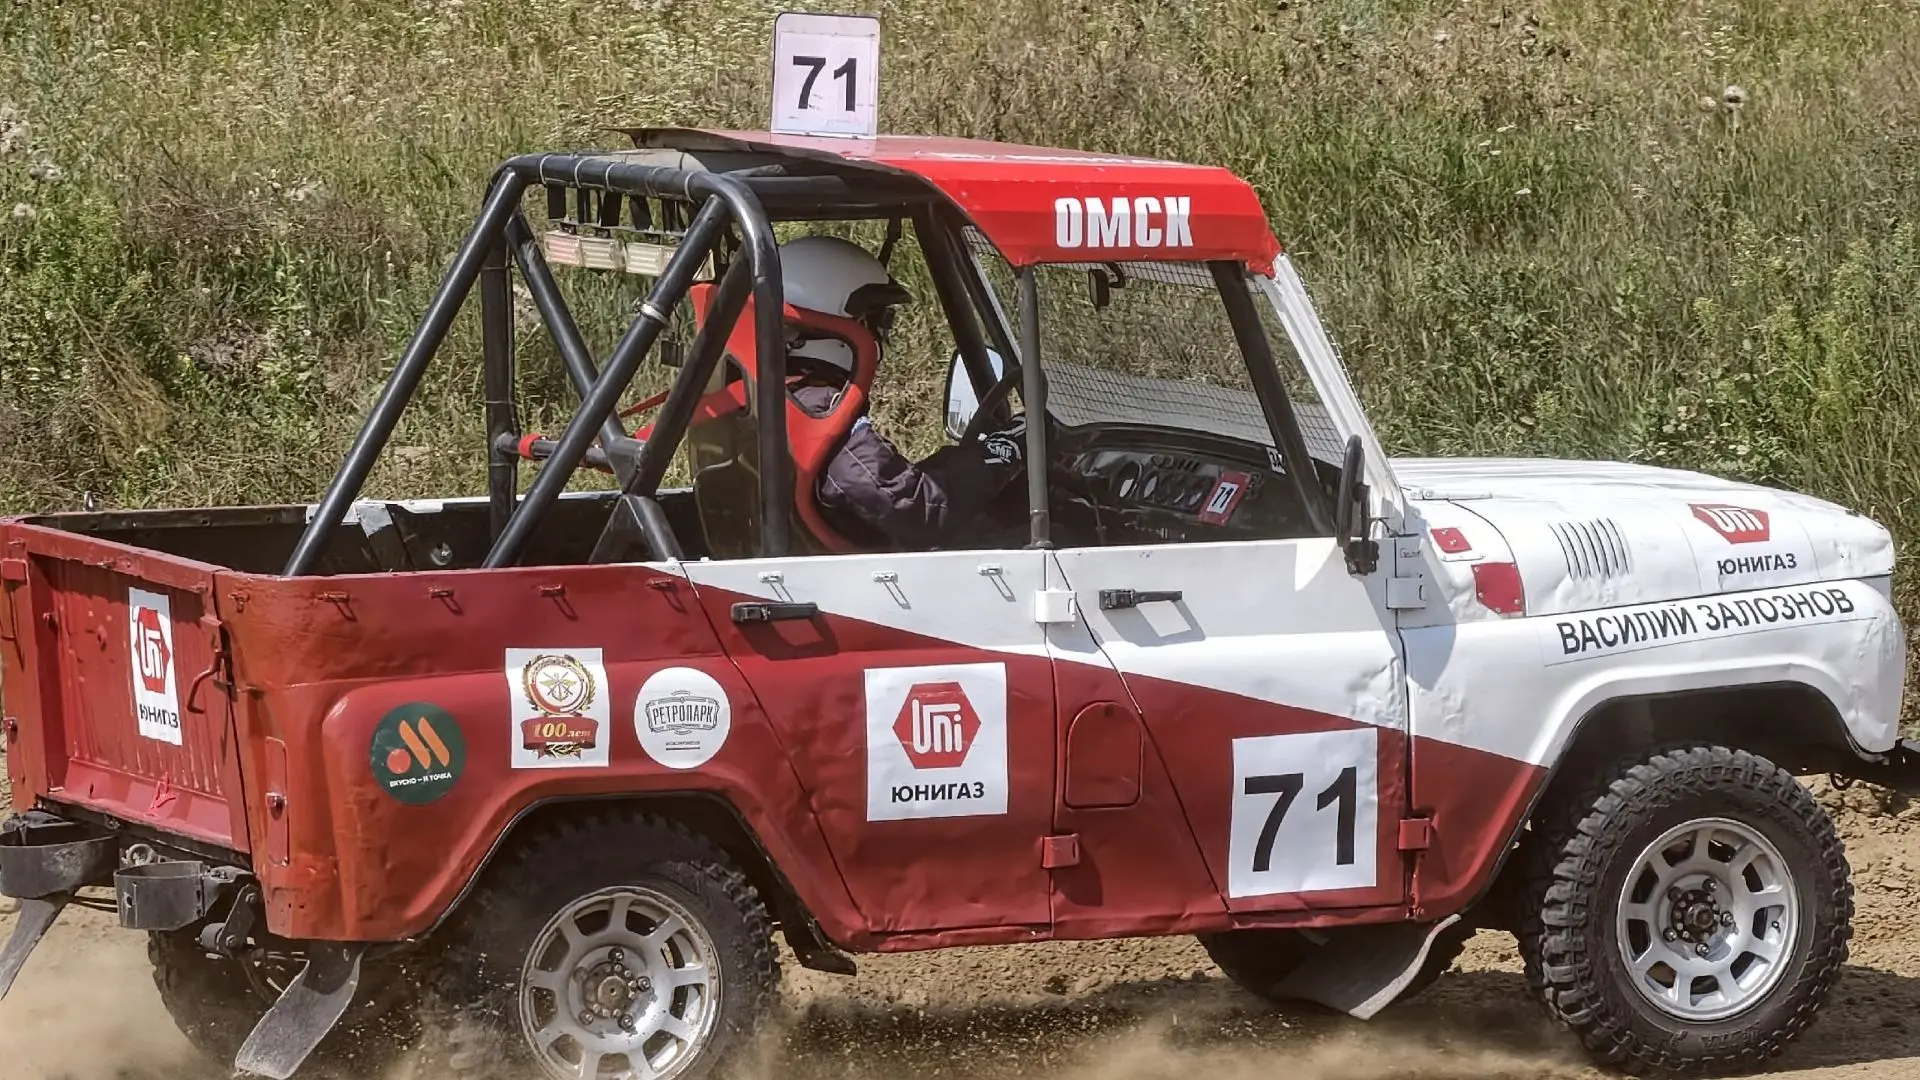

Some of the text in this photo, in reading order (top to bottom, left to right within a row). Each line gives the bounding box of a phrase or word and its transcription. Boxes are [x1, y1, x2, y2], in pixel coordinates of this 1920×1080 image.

[793, 55, 857, 112] 71
[1055, 196, 1194, 248] ОМСК
[1211, 486, 1235, 509] 71
[1717, 552, 1798, 576] ЮНИГАЗ
[1556, 588, 1855, 655] ВАСИЛИЙ ЗАЛОЗНОВ
[652, 704, 714, 725] РЕТРОПАРК
[533, 721, 567, 738] 100
[891, 781, 985, 803] ЮНИГАЗ
[1245, 766, 1357, 872] 71
